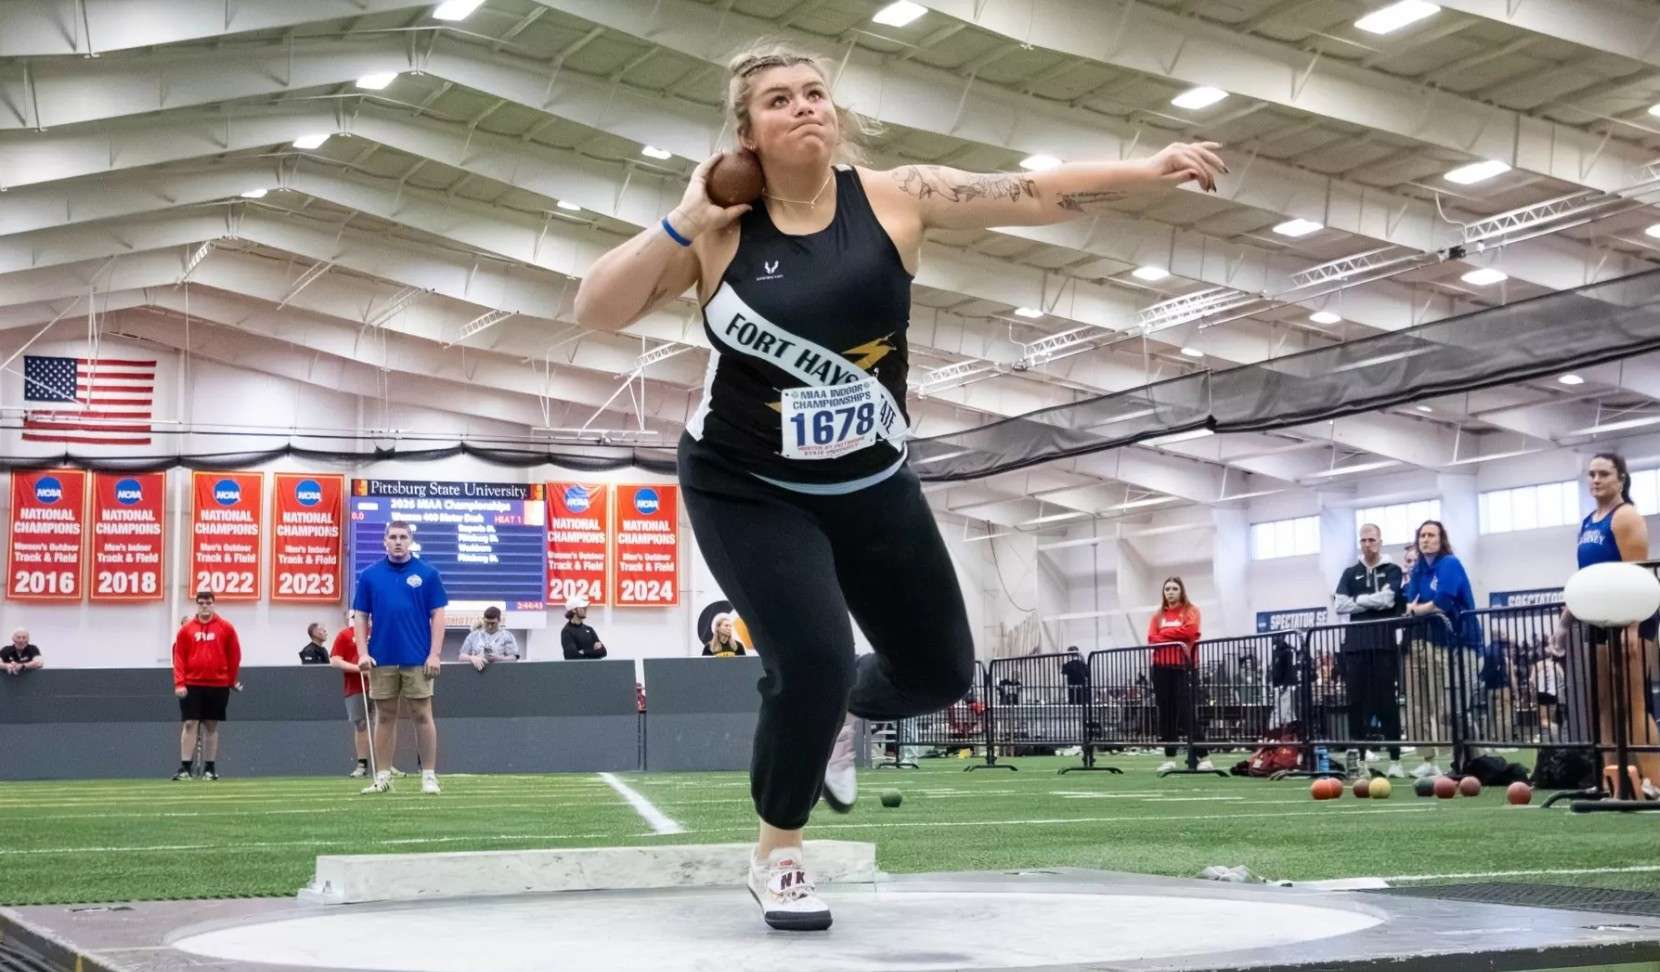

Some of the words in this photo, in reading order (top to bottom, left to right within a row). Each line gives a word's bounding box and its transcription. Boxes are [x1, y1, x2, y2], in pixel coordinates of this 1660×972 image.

[725, 313, 796, 358] FORT
[800, 390, 827, 400] MIAA
[830, 384, 863, 398] INDOOR
[793, 391, 871, 410] CHAMPIONSHIPS
[790, 403, 874, 447] 1678
[371, 480, 427, 497] Pittsburg
[429, 481, 460, 496] State
[20, 508, 75, 521] NATIONAL
[102, 508, 155, 521] NATIONAL
[201, 509, 253, 521] NATIONAL
[283, 512, 333, 523] NATIONAL
[495, 515, 515, 524] HEAT
[14, 522, 81, 535] CHAMPIONS
[96, 522, 161, 535] CHAMPIONS
[195, 522, 258, 535] CHAMPIONS
[553, 518, 600, 530] NATIONAL
[623, 520, 670, 531] NATIONAL
[277, 525, 339, 537] CHAMPIONS
[548, 531, 605, 543] CHAMPIONS
[618, 533, 676, 544] CHAMPIONS
[15, 551, 41, 562] Track
[44, 552, 51, 562] &
[54, 553, 77, 563] Field
[97, 552, 123, 562] Track
[125, 553, 133, 562] &
[136, 553, 159, 563] Field
[196, 552, 222, 562] Track
[224, 553, 232, 562] &
[234, 553, 256, 563] Field
[278, 554, 303, 564] Track
[305, 555, 313, 564] &
[315, 555, 337, 565] Field
[549, 561, 573, 571] Track
[574, 562, 581, 571] &
[583, 561, 604, 570] Field
[620, 562, 643, 571] Track
[645, 562, 652, 571] &
[654, 562, 674, 572] Field
[15, 570, 75, 594] 2016
[98, 571, 156, 593] 2018
[196, 570, 254, 593] 2022
[279, 572, 334, 595] 2023
[549, 579, 602, 600] 2024
[621, 580, 673, 601] 2024
[1508, 592, 1564, 607] SPECTATO
[1270, 611, 1315, 630] SPECTATOR
